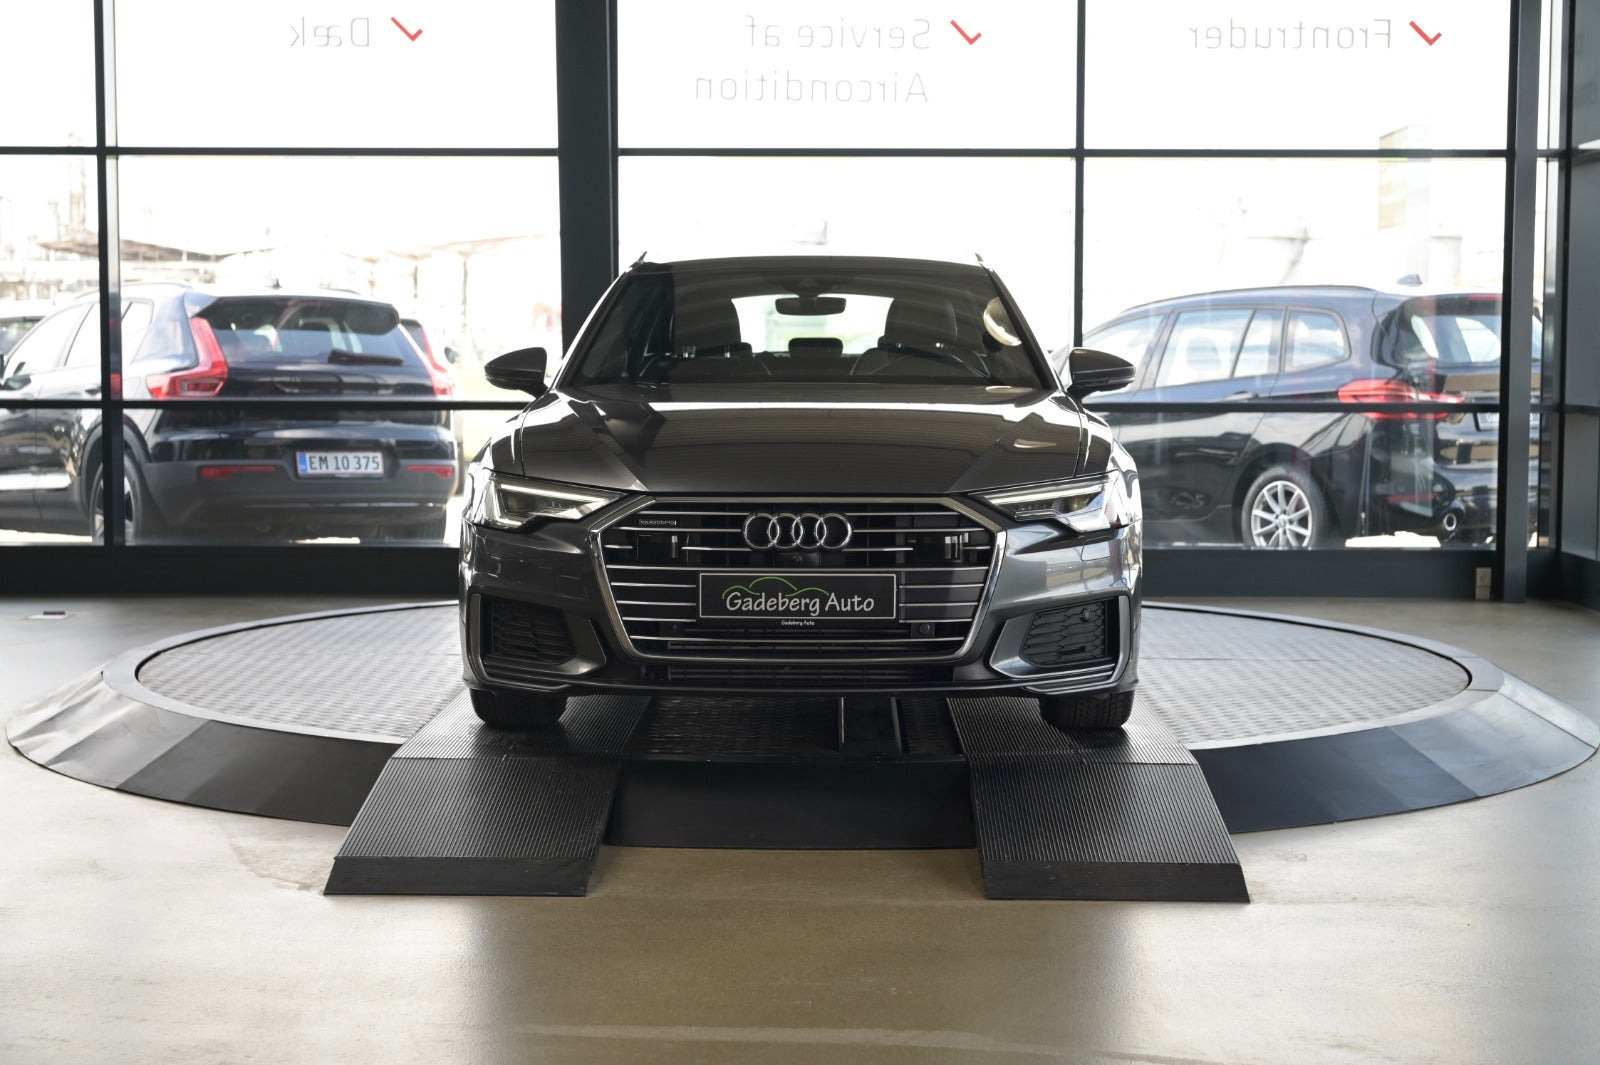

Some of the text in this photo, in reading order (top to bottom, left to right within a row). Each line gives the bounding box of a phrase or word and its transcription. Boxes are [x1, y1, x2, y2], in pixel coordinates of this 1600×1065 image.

[308, 455, 380, 471] EM 10 375
[726, 591, 875, 616] Gadeberg Auto
